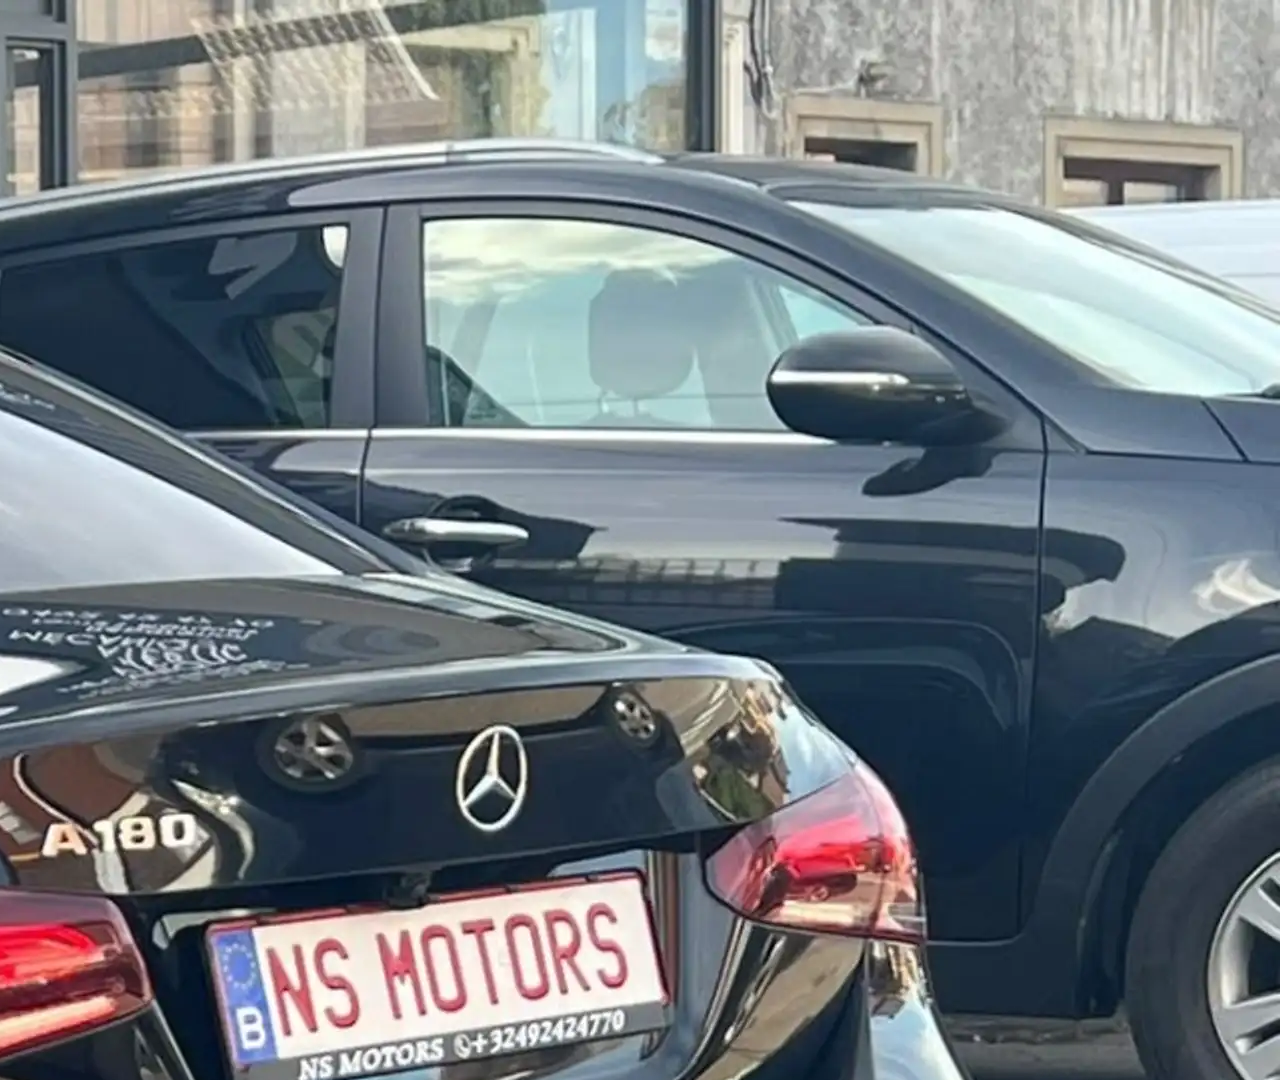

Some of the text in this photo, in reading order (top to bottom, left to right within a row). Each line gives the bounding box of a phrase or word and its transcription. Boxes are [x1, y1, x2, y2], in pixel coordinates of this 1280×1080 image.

[266, 902, 629, 1036] NS MOTORS
[236, 1006, 266, 1050] B
[338, 1037, 445, 1076] MOTORS
